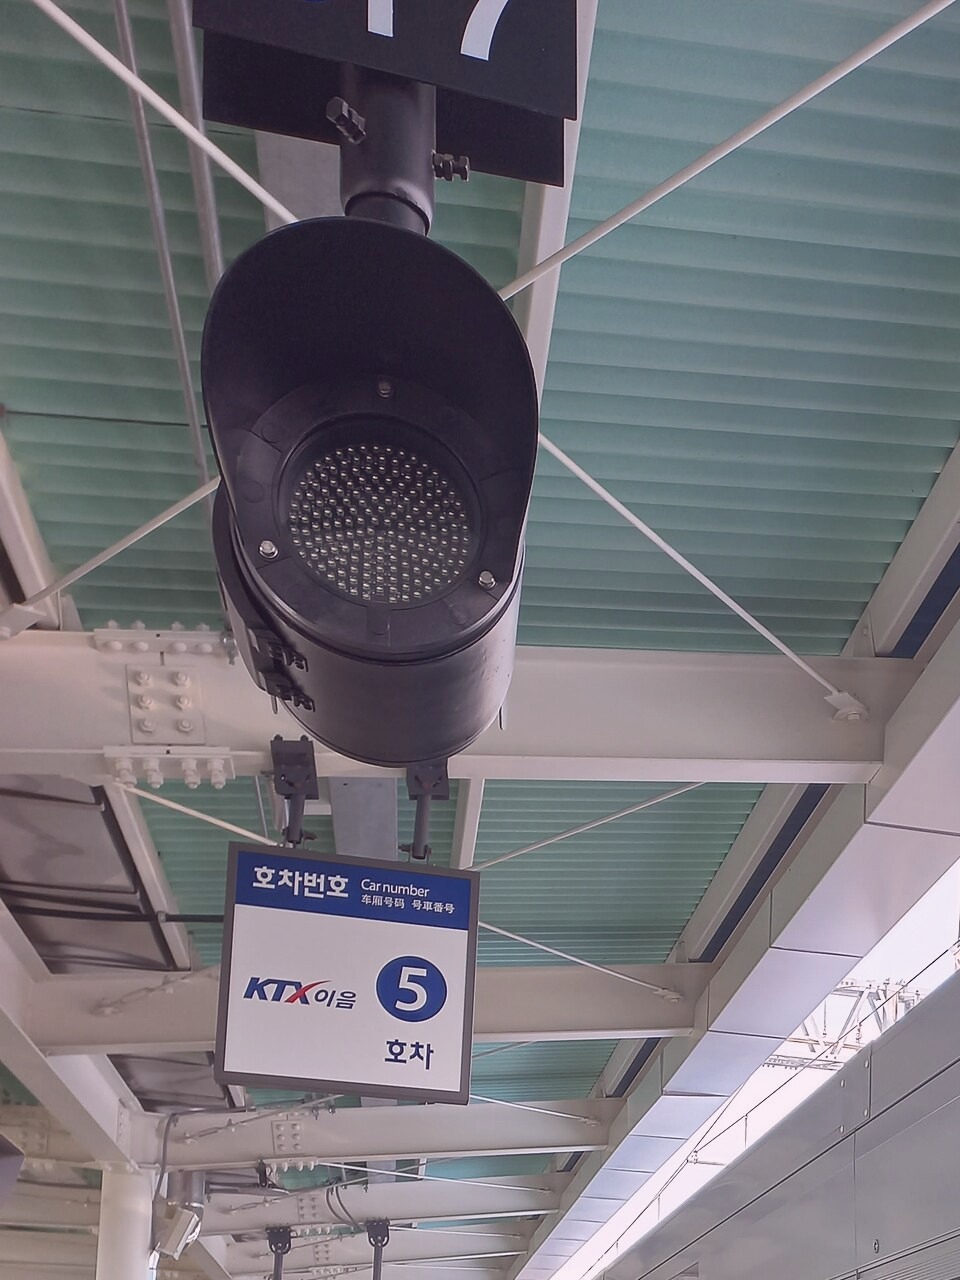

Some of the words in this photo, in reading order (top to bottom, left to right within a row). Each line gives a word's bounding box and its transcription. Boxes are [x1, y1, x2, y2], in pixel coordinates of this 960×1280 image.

[252, 866, 349, 898] 호차번호
[361, 879, 381, 892] Car
[382, 884, 430, 898] number
[395, 966, 428, 1012] 5
[384, 1039, 434, 1070] 호차
